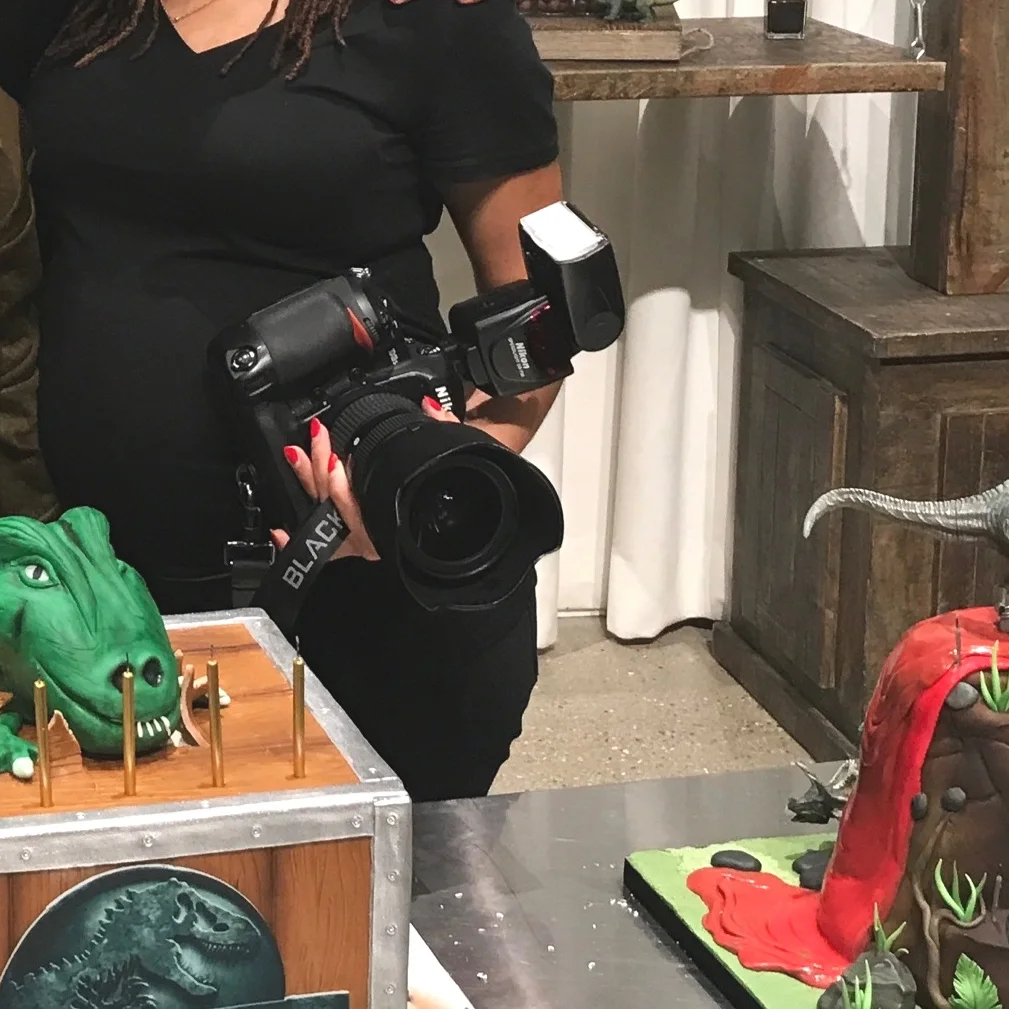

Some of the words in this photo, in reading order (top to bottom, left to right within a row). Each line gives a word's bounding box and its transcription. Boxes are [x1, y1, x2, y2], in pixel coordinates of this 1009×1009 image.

[515, 342, 530, 369] Nikon
[434, 385, 453, 412] Nik
[282, 509, 343, 590] BLACK
